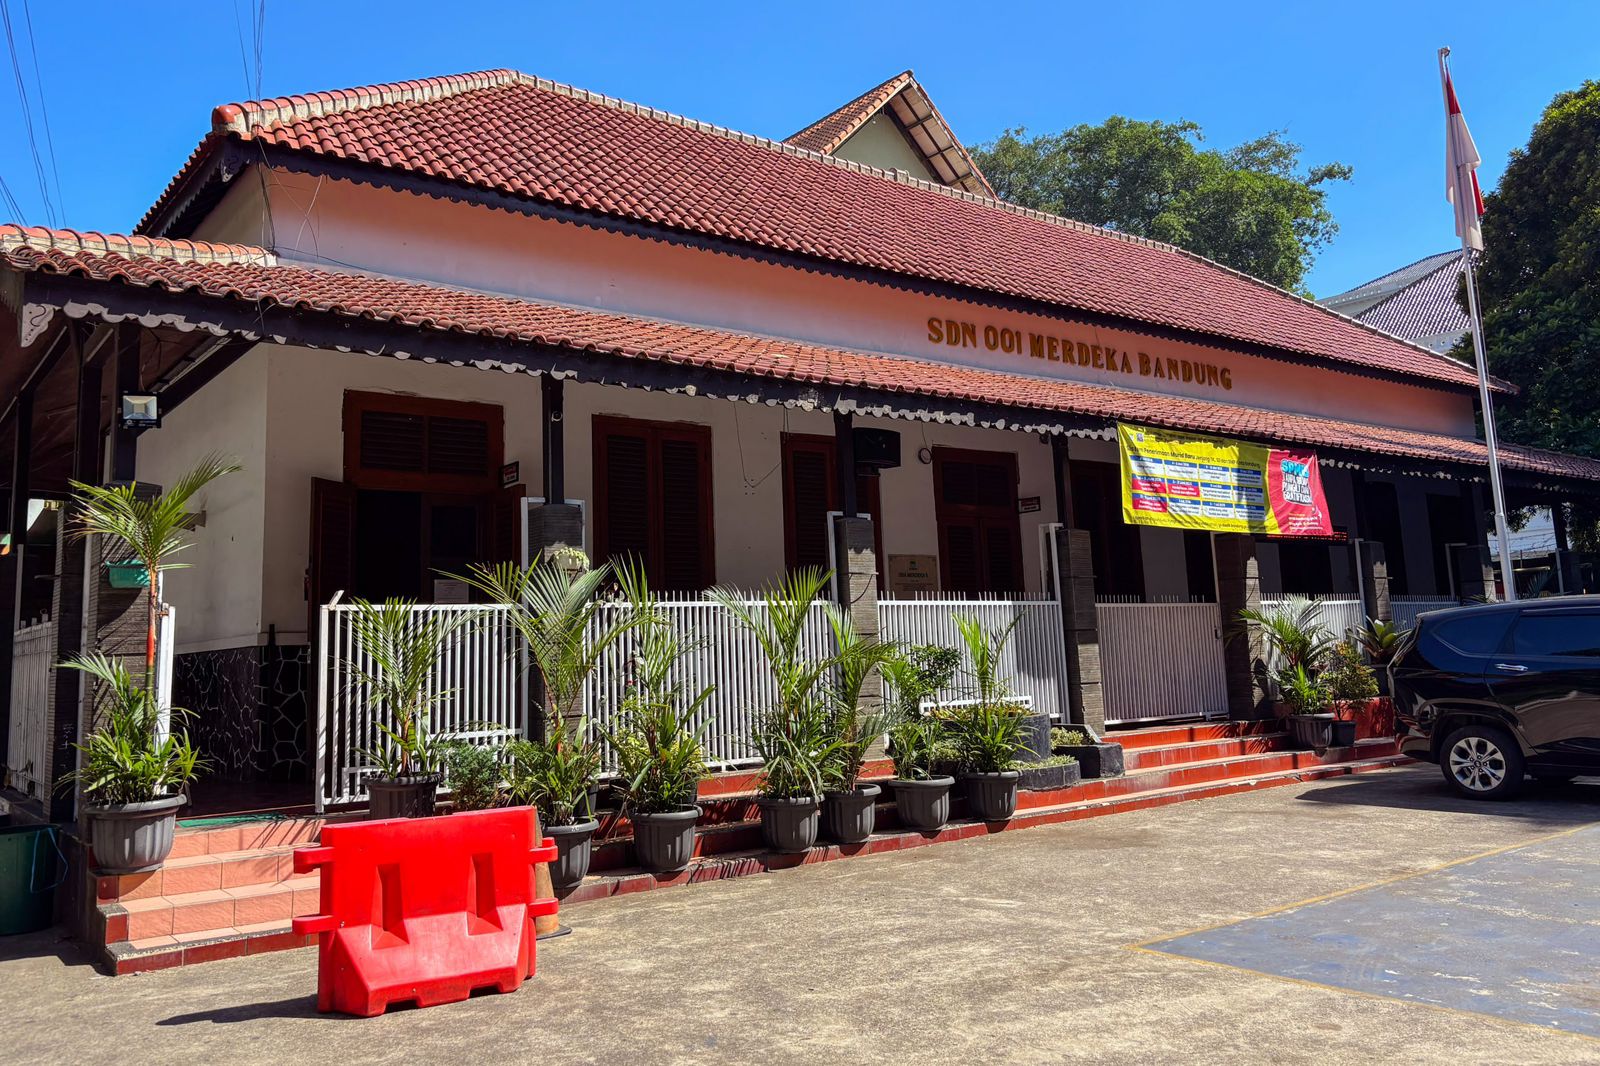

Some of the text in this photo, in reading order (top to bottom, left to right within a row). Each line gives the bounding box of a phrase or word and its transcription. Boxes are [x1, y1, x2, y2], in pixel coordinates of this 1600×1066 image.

[927, 317, 977, 348] SDN
[1029, 333, 1133, 374] MERDEKA
[1138, 352, 1233, 390] BANDUNG
